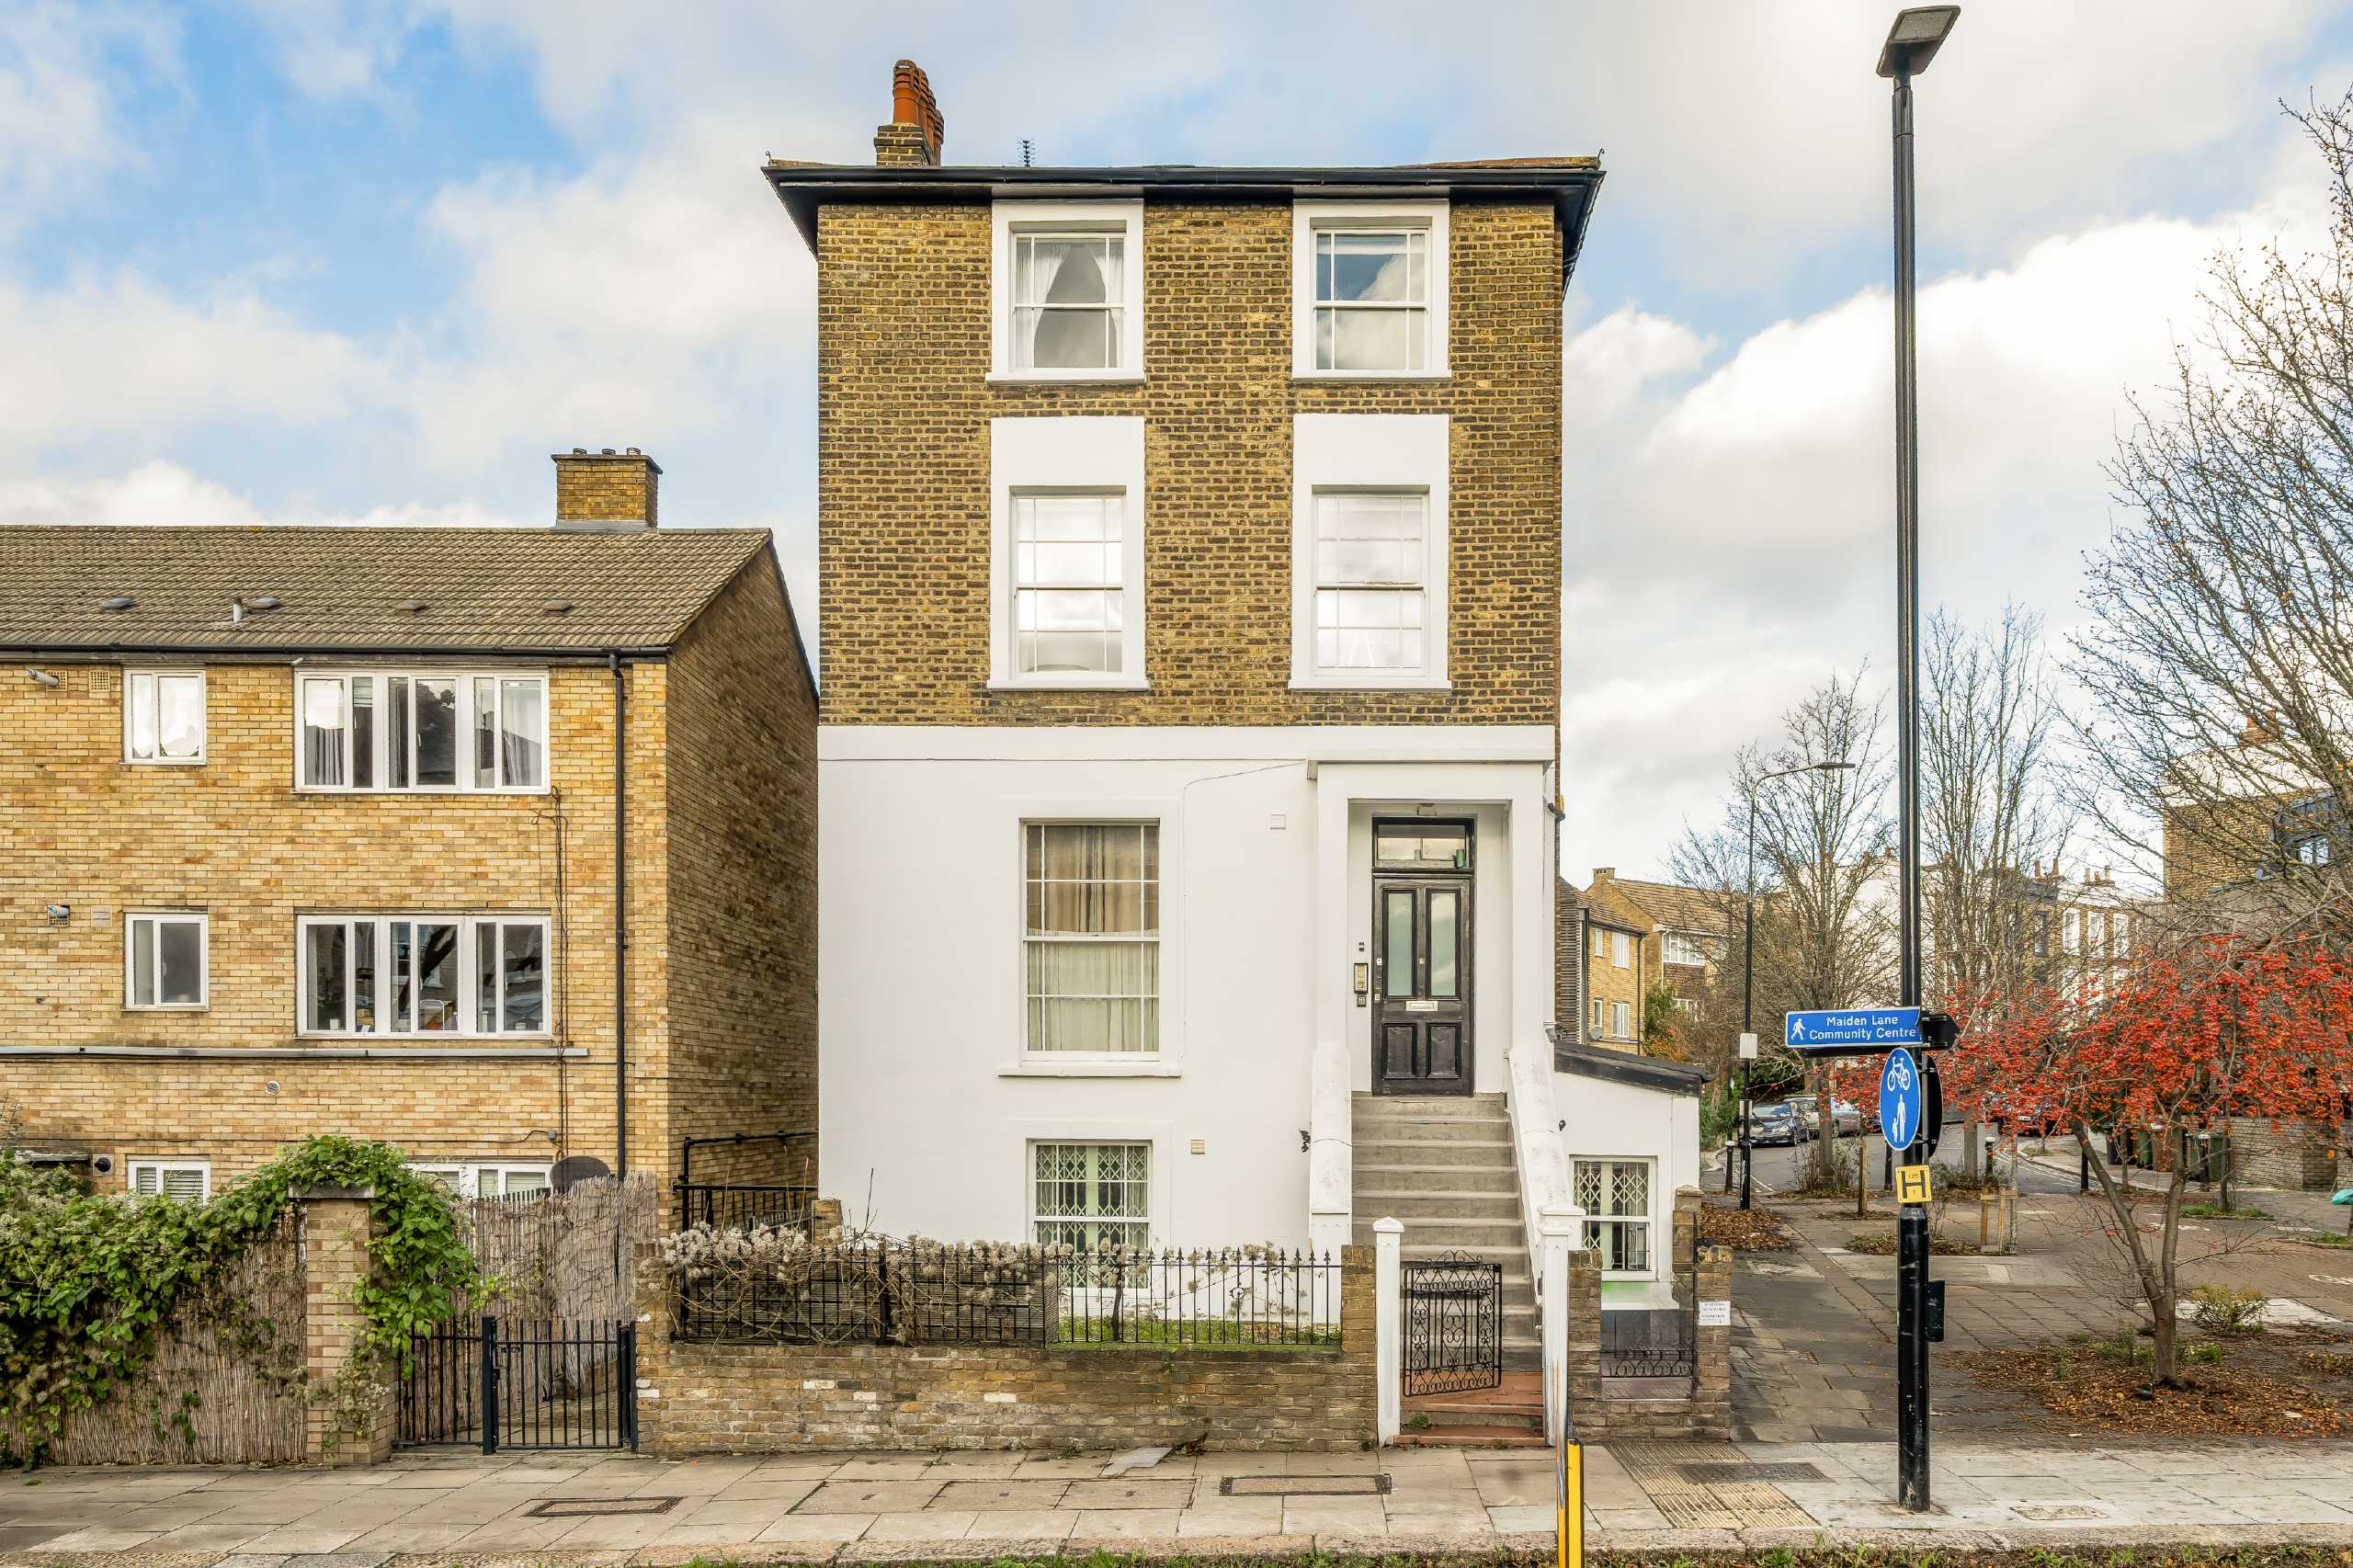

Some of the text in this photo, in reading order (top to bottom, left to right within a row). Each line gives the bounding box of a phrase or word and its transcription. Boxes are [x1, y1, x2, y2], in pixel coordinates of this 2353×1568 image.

[1826, 1015, 1898, 1027] Maiden Lane
[1809, 1028, 1916, 1040] Community Centre
[1901, 1170, 1927, 1199] H
